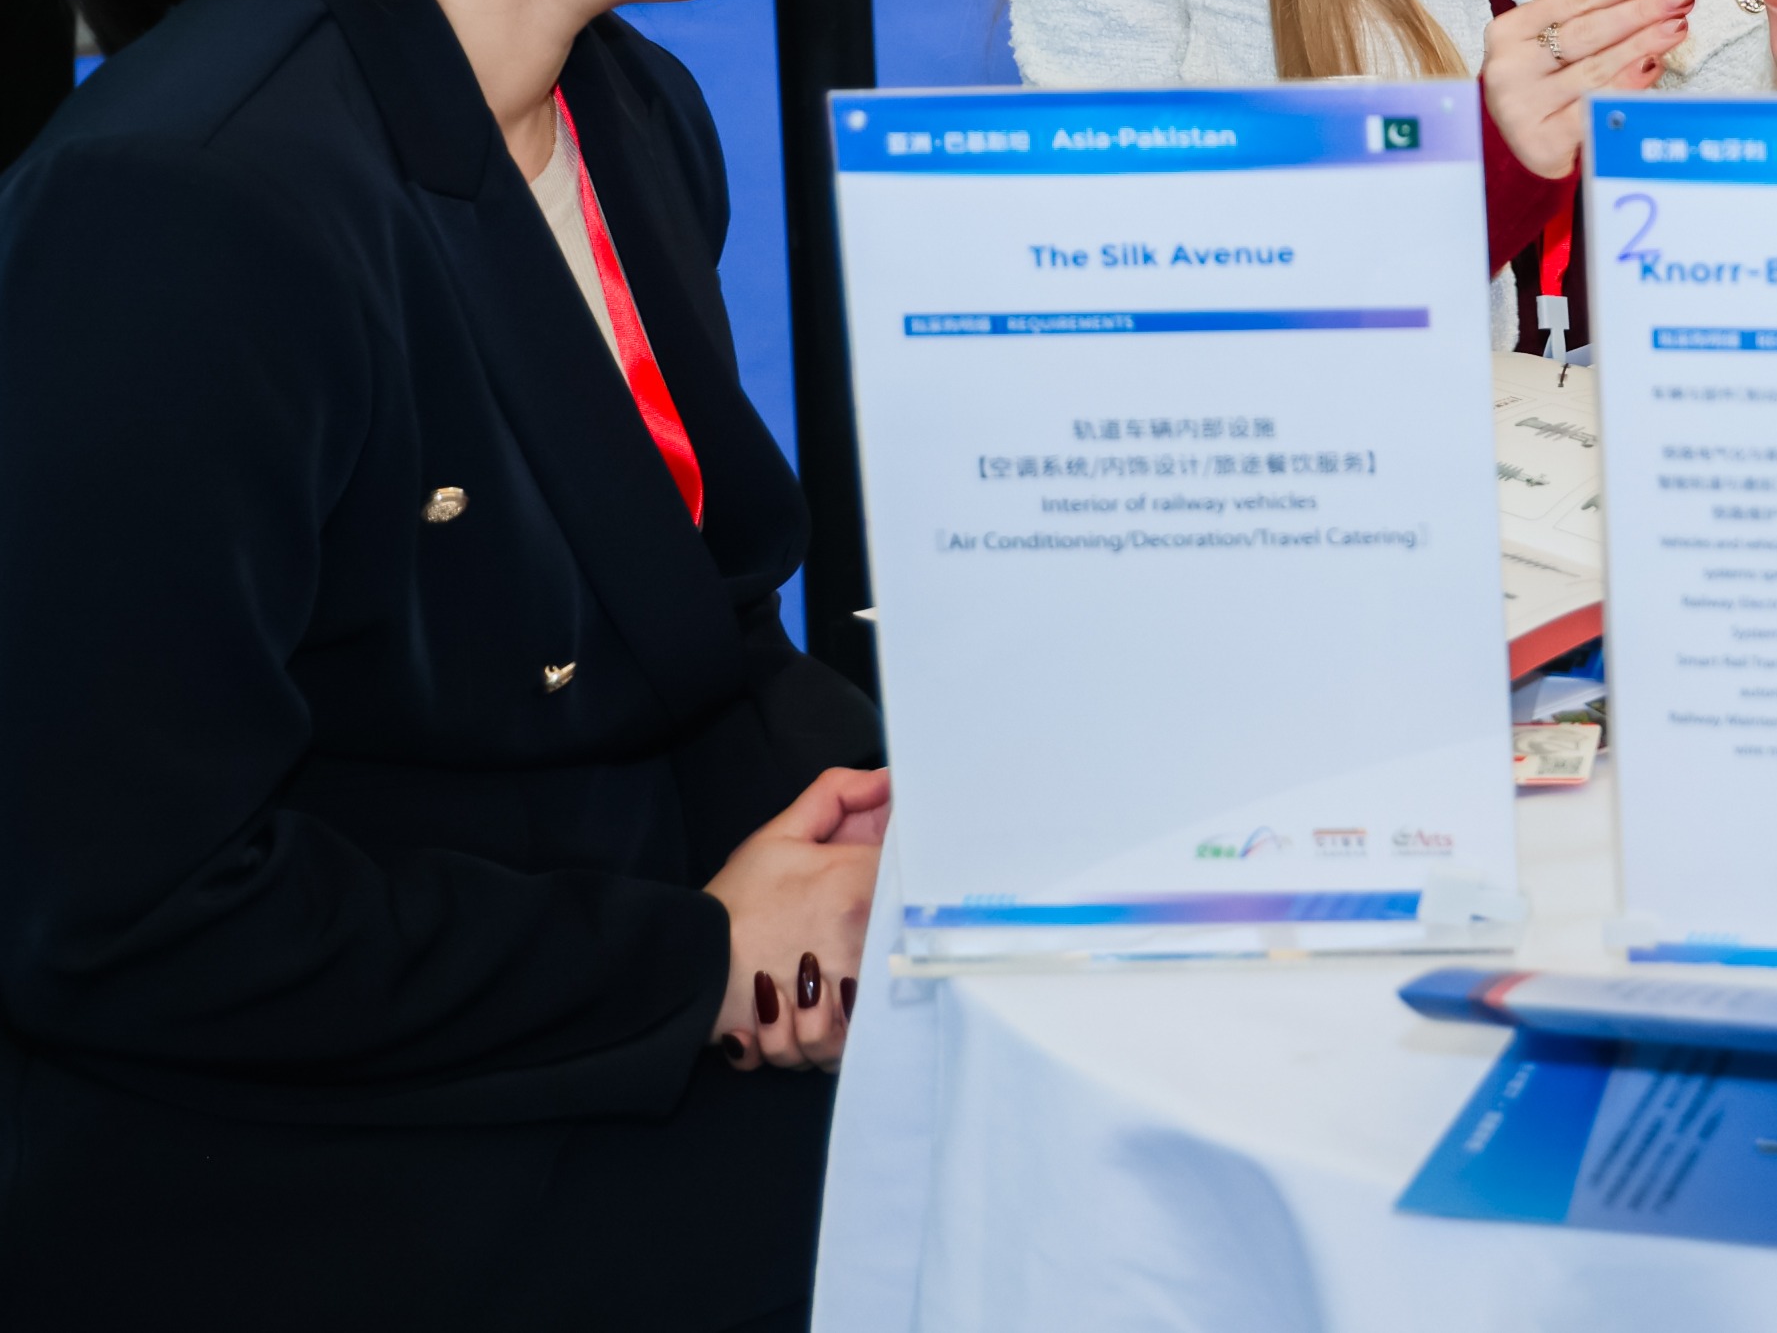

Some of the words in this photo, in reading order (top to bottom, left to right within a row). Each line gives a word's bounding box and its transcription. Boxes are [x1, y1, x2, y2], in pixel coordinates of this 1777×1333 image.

[1613, 193, 1662, 262] 2
[1029, 244, 1089, 269] The
[1101, 243, 1159, 268] Silk
[1170, 242, 1296, 267] Avenue
[1007, 315, 1135, 335] REQUIREMENTS
[1073, 416, 1275, 442] 轨道车辆内部设施
[1041, 495, 1119, 513] Interior
[1125, 492, 1146, 512] of
[1153, 492, 1225, 517] railway
[1233, 490, 1318, 511] vehicles
